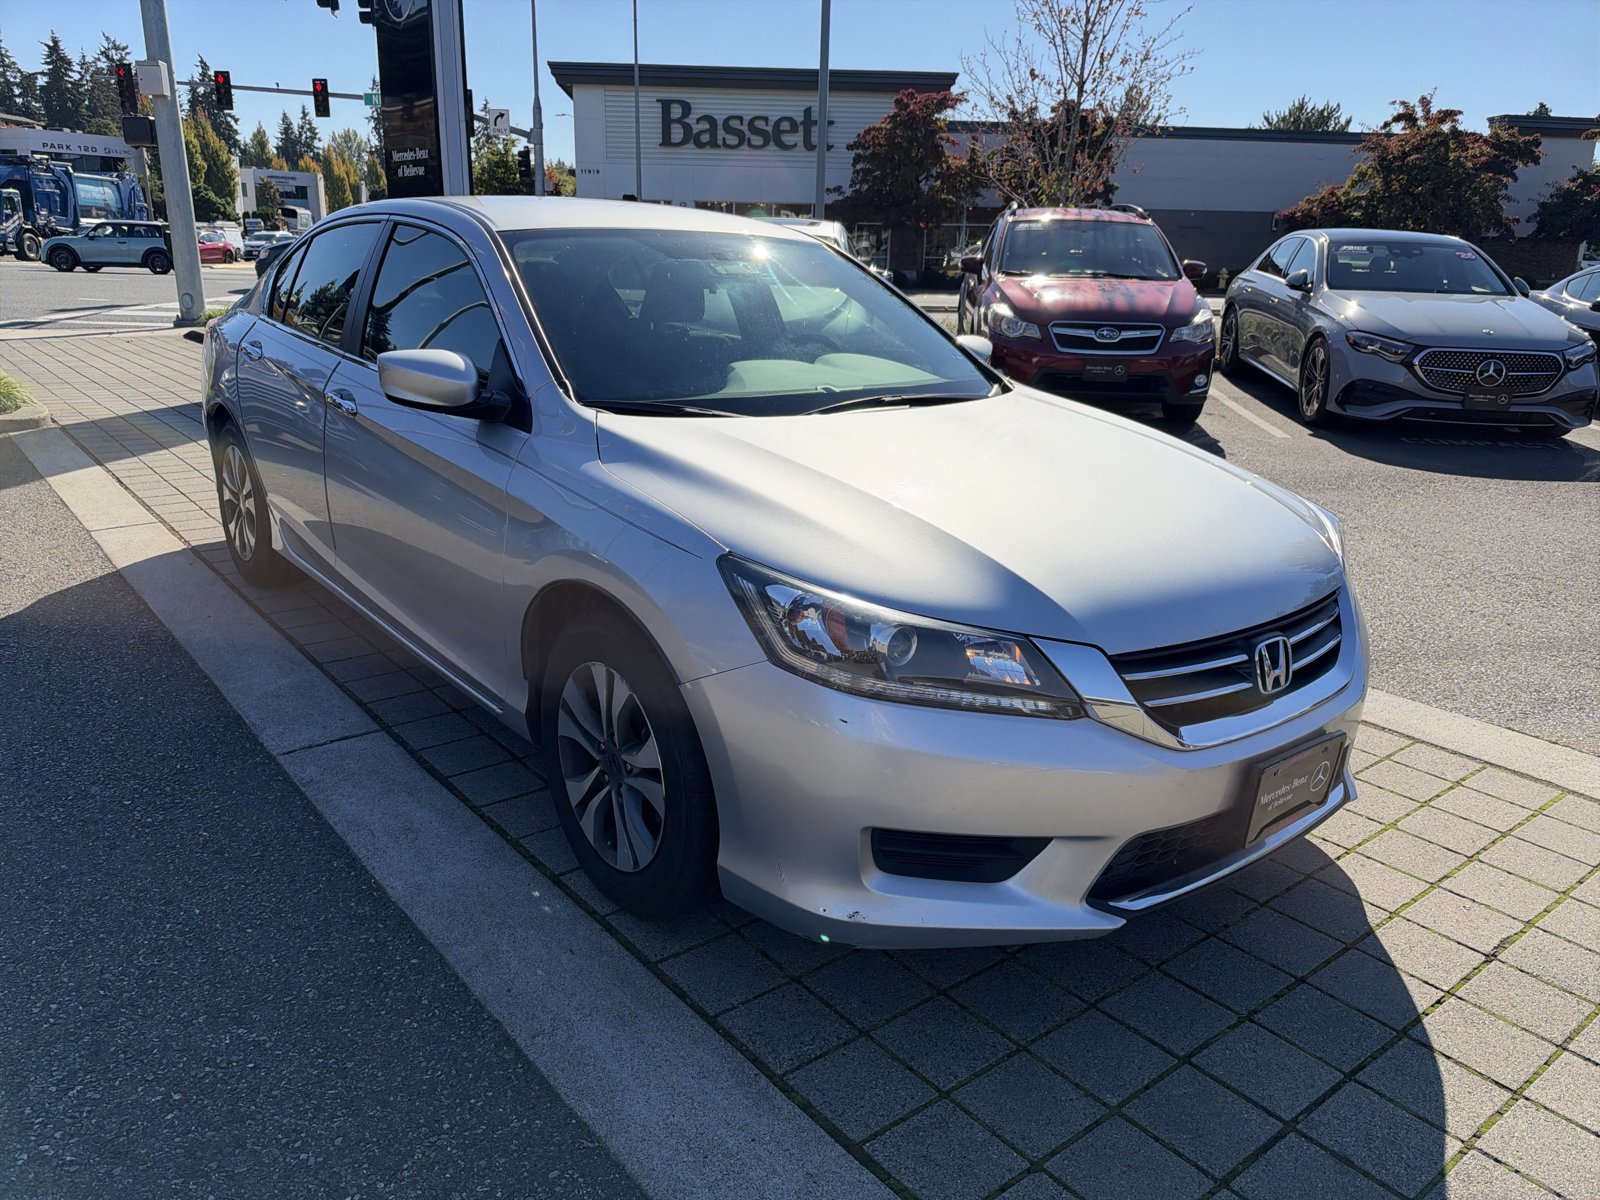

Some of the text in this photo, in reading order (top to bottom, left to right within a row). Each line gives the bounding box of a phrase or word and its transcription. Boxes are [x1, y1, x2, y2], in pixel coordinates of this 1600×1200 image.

[42, 142, 72, 151] PARK
[78, 145, 97, 153] 120
[392, 147, 429, 162] Mercedes-Benz
[397, 165, 425, 177] of Bellevue
[1261, 775, 1309, 806] Mercedes-Benz
